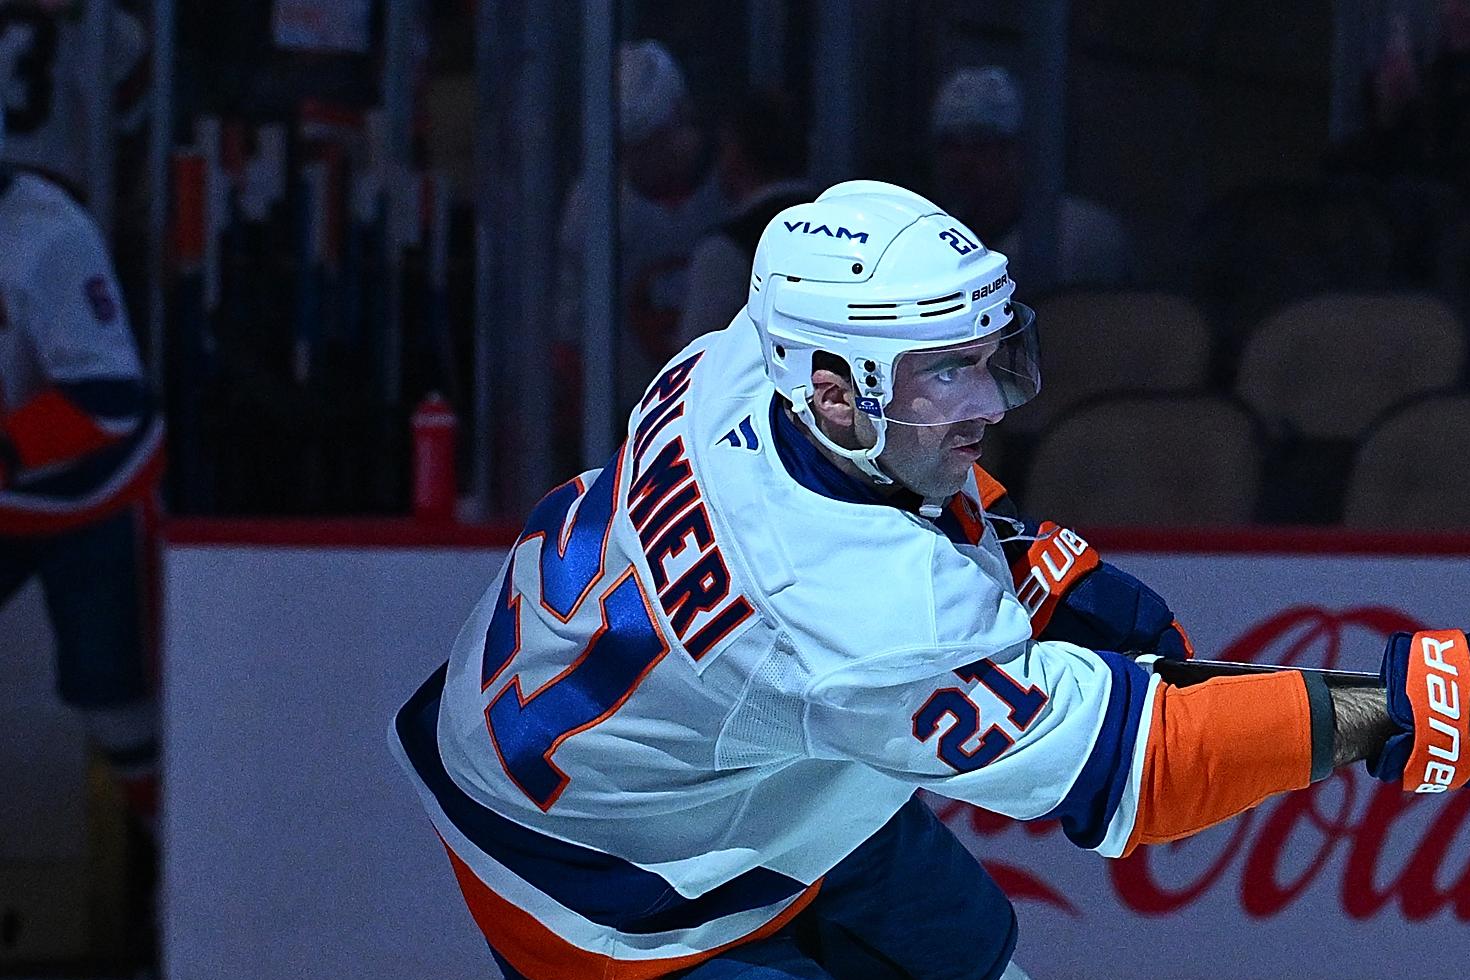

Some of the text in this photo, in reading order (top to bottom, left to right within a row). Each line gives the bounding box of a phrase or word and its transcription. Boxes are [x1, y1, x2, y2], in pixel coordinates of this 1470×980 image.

[783, 220, 869, 244] VIAM
[938, 227, 979, 256] 21
[971, 274, 1009, 302] BAUER
[626, 349, 756, 662] PALMIERI
[481, 433, 671, 813] 21
[911, 657, 1050, 775] 21
[1414, 635, 1461, 794] BAUER
